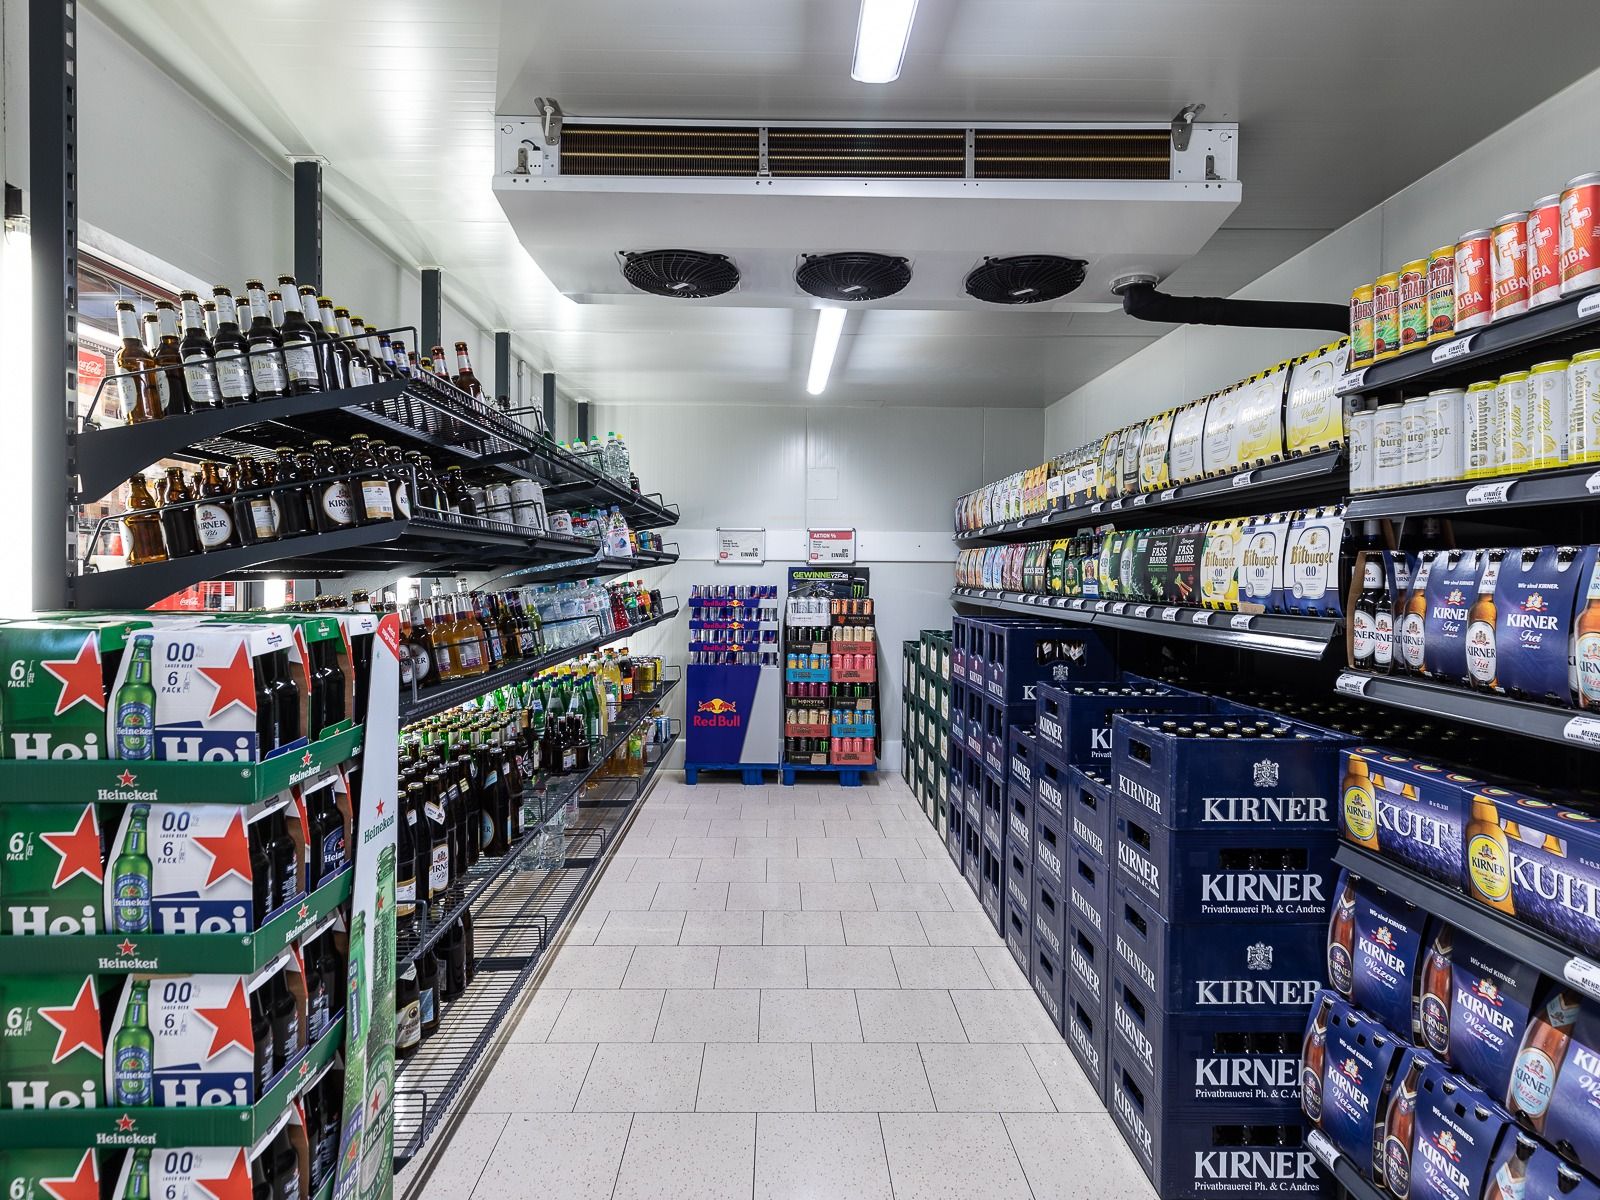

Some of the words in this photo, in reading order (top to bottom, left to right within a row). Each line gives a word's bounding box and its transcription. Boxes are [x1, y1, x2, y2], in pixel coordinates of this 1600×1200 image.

[1151, 547, 1168, 557] FASS
[1177, 545, 1194, 555] FASS
[1205, 551, 1235, 569] Bitburger
[1243, 549, 1278, 568] Bitburger
[1290, 545, 1334, 566] Bitburger
[792, 571, 830, 579] GEWINNE
[1442, 620, 1460, 632] Frei
[1507, 613, 1558, 630] KIRNER
[1520, 630, 1543, 643] Frei
[166, 642, 195, 662] 0.0
[1467, 645, 1496, 659] KIRNER
[10, 660, 25, 681] 6
[1473, 658, 1490, 670] Frei
[7, 680, 25, 688] PACK
[168, 671, 178, 686] 6
[988, 680, 1003, 697] KIRNER
[693, 715, 717, 727] Red
[718, 715, 741, 727] Bull
[1040, 716, 1062, 742] KIRNER
[288, 762, 322, 785] Heineken
[1012, 756, 1031, 784] KIRNER
[97, 789, 158, 800] Heineken
[1040, 778, 1062, 809] KIRNER
[1118, 773, 1162, 815] KIRNER
[1201, 797, 1330, 822] KIRNER
[1346, 803, 1373, 821] KIRNER
[162, 812, 189, 831] 0.0
[364, 813, 395, 844] Heineken
[1011, 812, 1029, 843] KIRNER
[1376, 799, 1450, 850] KULT
[9, 832, 24, 852] 6
[1073, 817, 1104, 856] KIRNER
[163, 842, 174, 856] 6
[1038, 841, 1061, 878] KIRNER
[1118, 840, 1160, 890] KIRNER
[1471, 855, 1505, 877] KIRNER
[1009, 877, 1028, 911] KIRNER
[1201, 873, 1326, 902] KIRNER
[1071, 886, 1102, 931] KIRNER
[1201, 904, 1259, 914] Privatbrauerei
[1261, 904, 1275, 914] Ph.
[1276, 904, 1284, 914] &
[1285, 904, 1294, 914] C.
[1296, 904, 1325, 914] Andres
[1369, 908, 1377, 917] Wir
[1378, 914, 1388, 922] sind
[285, 911, 318, 944] Heineken
[1036, 913, 1060, 955] KIRNER
[98, 958, 158, 969] Heineken
[1116, 935, 1156, 993] KIRNER
[1359, 936, 1406, 976] KIRNER
[1071, 945, 1101, 996] KIRNER
[1364, 956, 1398, 984] Weizen
[1470, 957, 1480, 966] Wir
[1480, 963, 1493, 974] sind
[1493, 970, 1517, 988] KIRNER.
[163, 982, 192, 1004] 0.0
[1035, 975, 1059, 1022] KIRNER
[1195, 980, 1322, 1005] KIRNER
[7, 1007, 22, 1027] 6
[164, 1013, 175, 1028] 6
[1457, 988, 1514, 1037] KIRNER
[4, 1028, 23, 1036] PACK
[1115, 1001, 1153, 1068] KIRNER
[1463, 1012, 1504, 1046] Weizen
[1070, 1015, 1100, 1074] KIRNER
[1195, 1058, 1303, 1086] KIRNE
[1514, 1065, 1551, 1098] KIRNER
[286, 1065, 318, 1104] Heineken
[1195, 1088, 1253, 1098] Privatbrauerei
[1255, 1088, 1268, 1098] Ph.
[1271, 1088, 1279, 1098] &
[1280, 1088, 1289, 1098] C.
[1328, 1065, 1369, 1113] KIRNER
[1516, 1081, 1542, 1106] Weizen
[1332, 1086, 1362, 1119] Weizen
[1114, 1082, 1153, 1158] KIRNER
[1432, 1105, 1441, 1117] Wir
[1441, 1114, 1454, 1127] sind
[96, 1132, 157, 1144] Heineken
[164, 1151, 193, 1174] 0.0
[1194, 1151, 1320, 1179] KIRNER
[1418, 1136, 1470, 1196] KIRNER
[9, 1177, 25, 1199] 6
[166, 1185, 176, 1200] 6
[1194, 1181, 1252, 1191] Privatbrauerei
[1254, 1181, 1268, 1191] Ph.
[1270, 1181, 1278, 1191] &
[1279, 1181, 1288, 1191] C.
[1289, 1181, 1319, 1191] Andres
